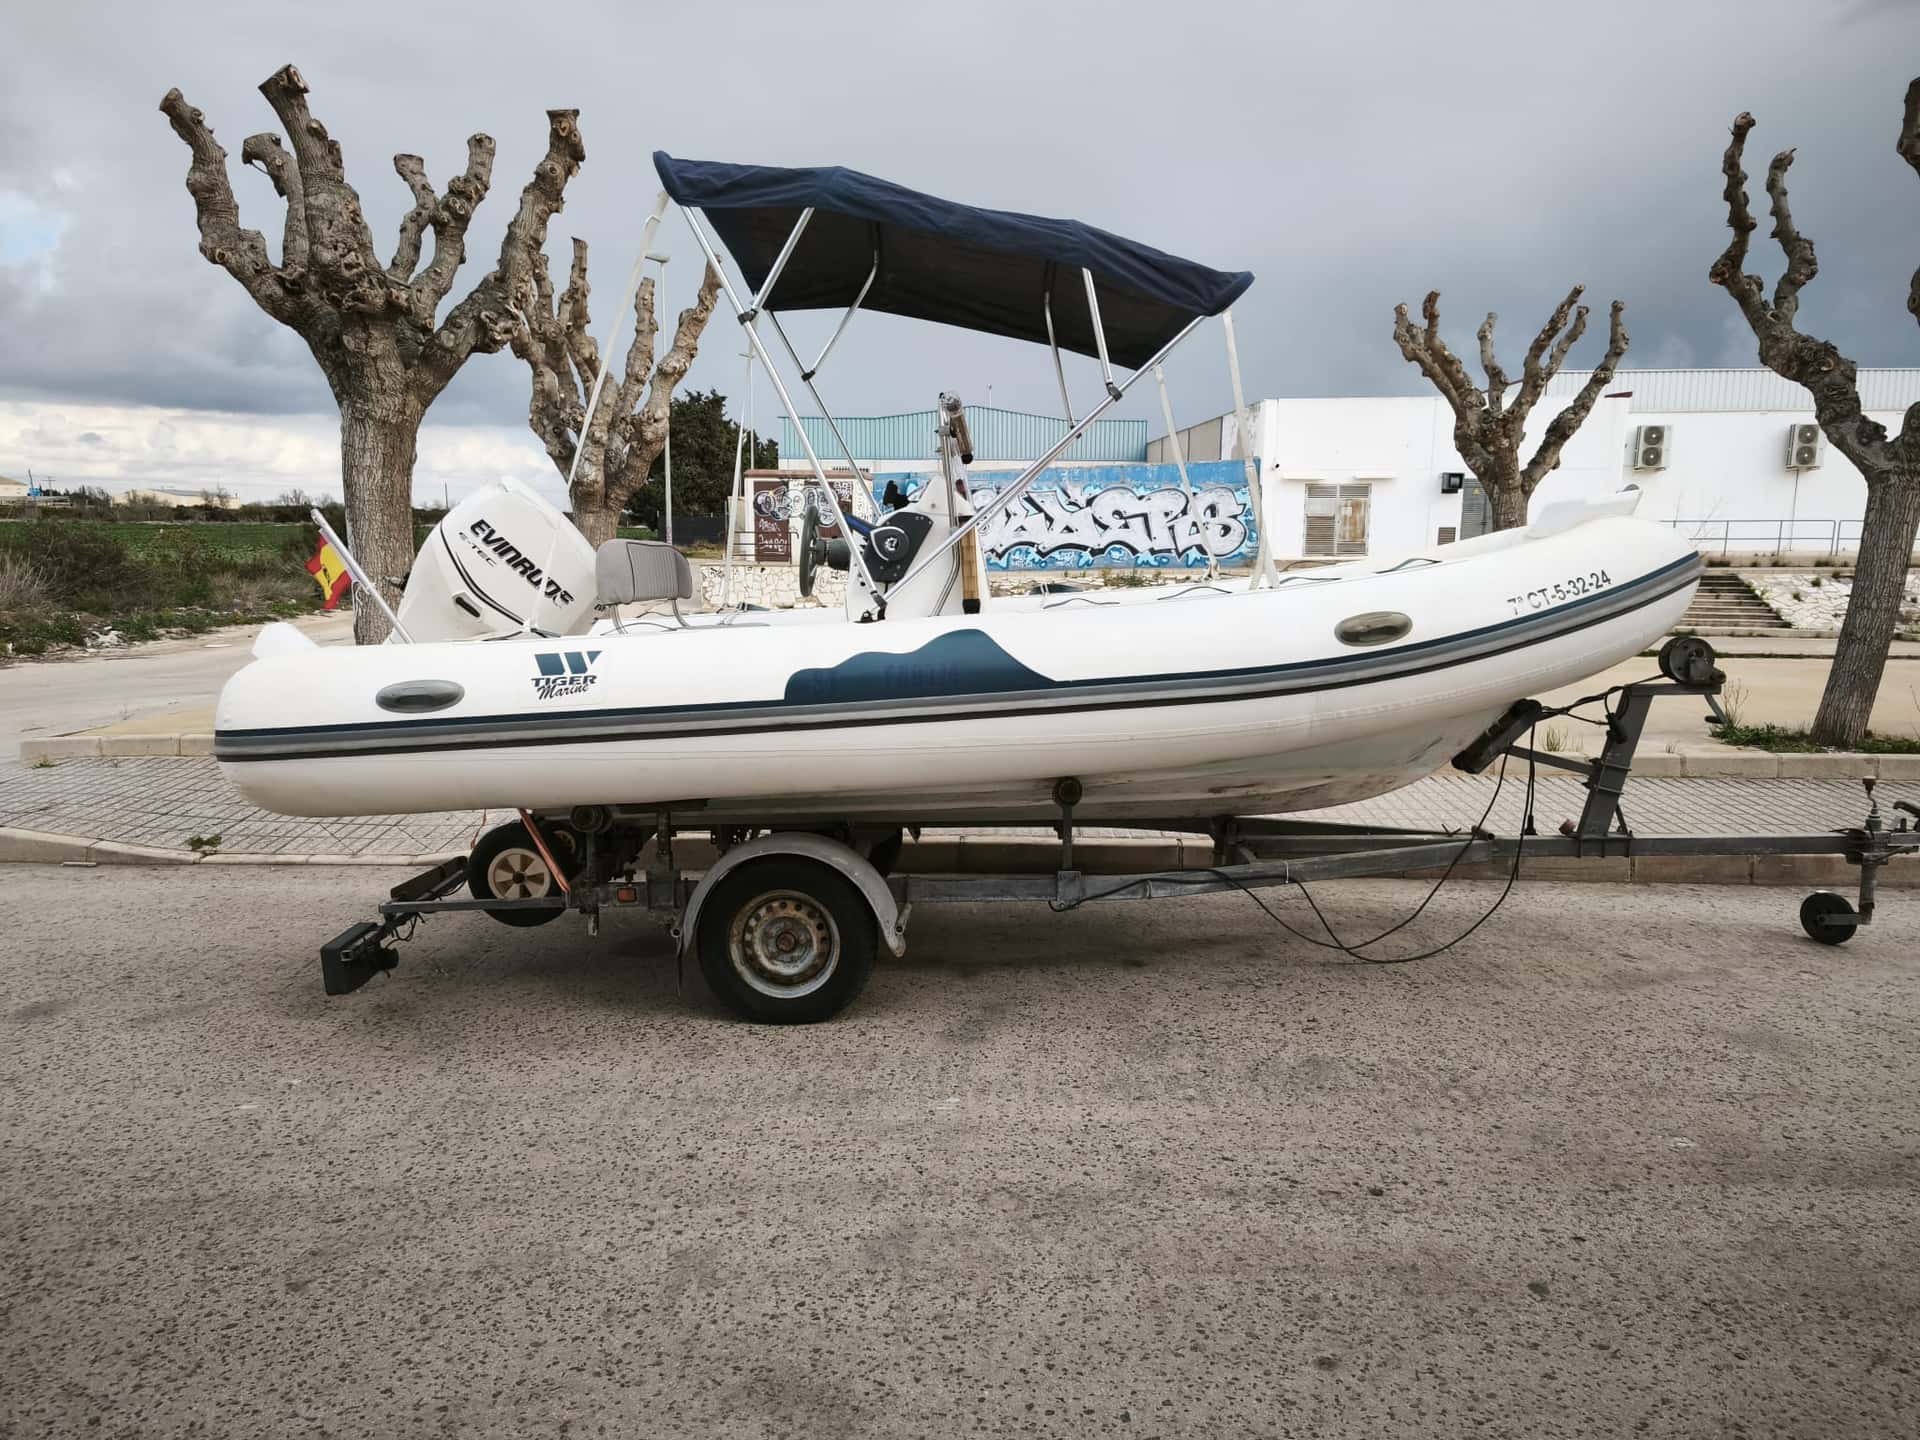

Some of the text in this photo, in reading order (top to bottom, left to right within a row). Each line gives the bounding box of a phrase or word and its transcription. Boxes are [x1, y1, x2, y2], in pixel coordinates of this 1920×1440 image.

[470, 518, 575, 608] EVINRUDE
[1527, 569, 1612, 609] CT-5-32-24
[530, 675, 598, 688] TIGER
[536, 683, 590, 701] Marine
